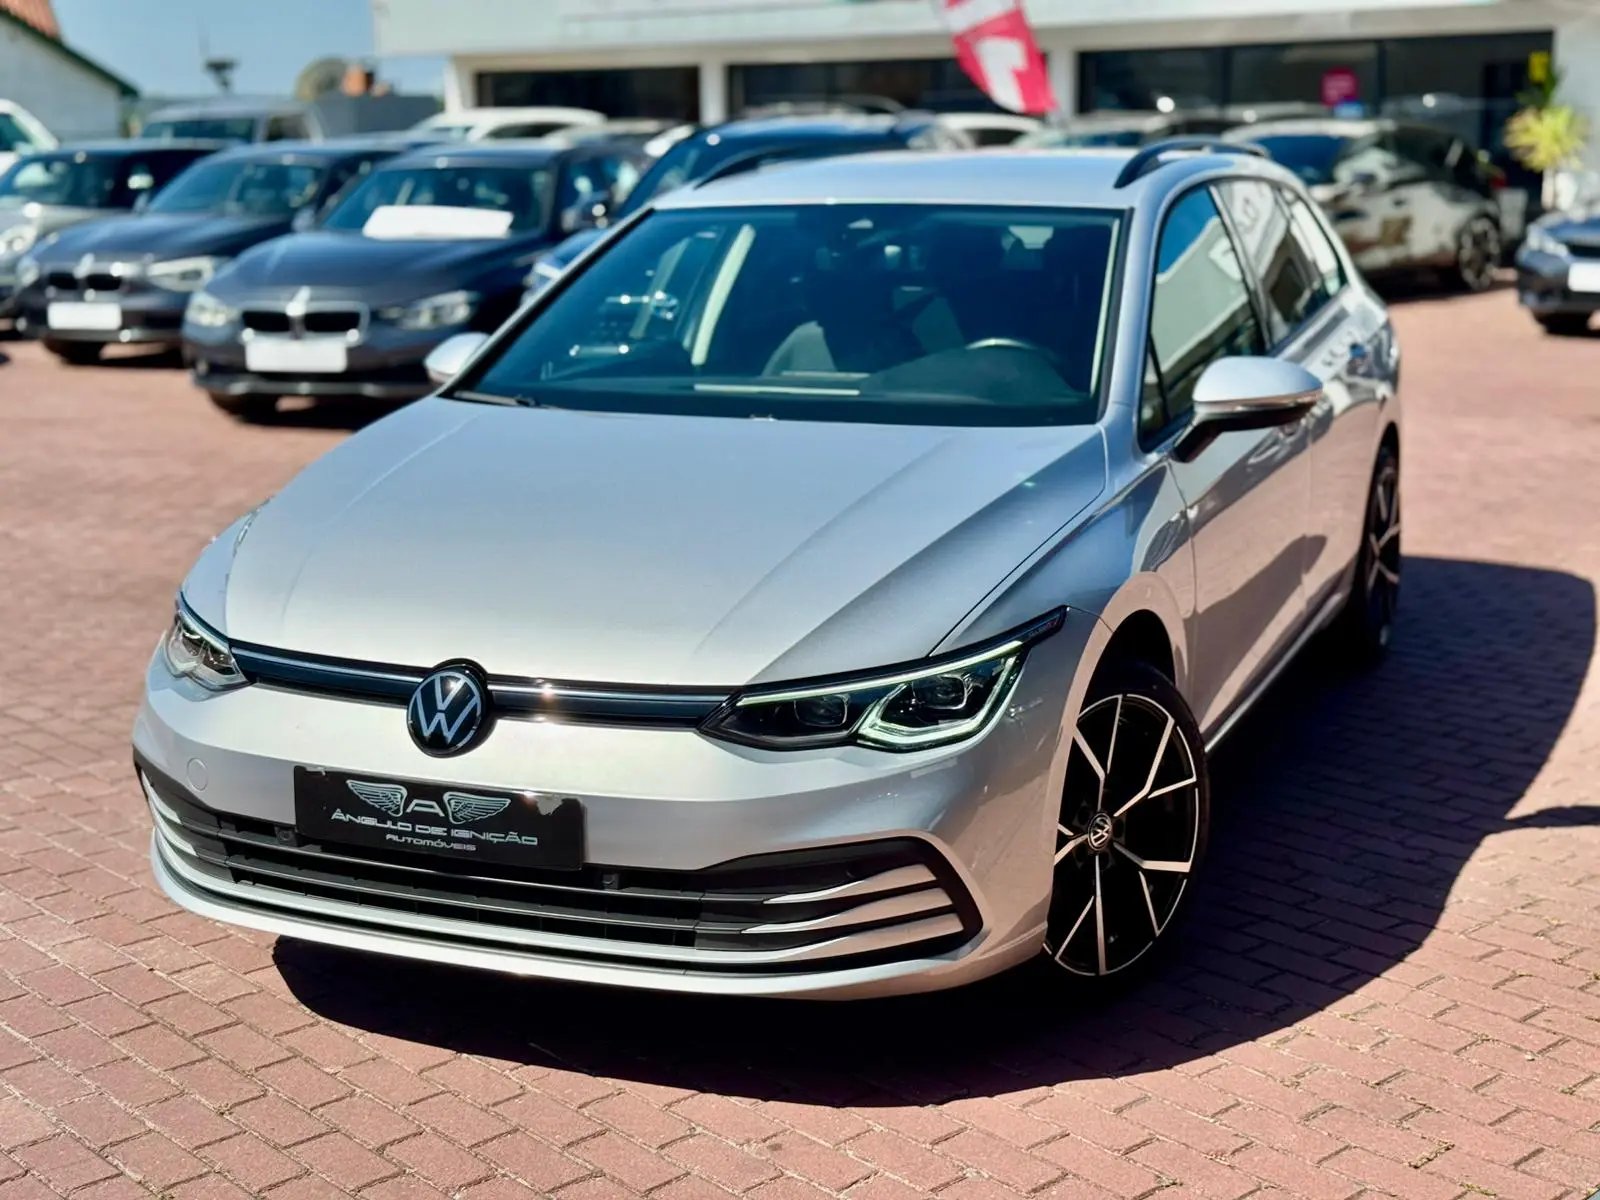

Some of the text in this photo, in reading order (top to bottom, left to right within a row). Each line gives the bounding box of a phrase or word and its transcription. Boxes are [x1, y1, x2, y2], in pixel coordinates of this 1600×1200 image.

[412, 671, 481, 745] VW
[406, 799, 445, 816] A
[331, 808, 538, 846] ÂNGULO DE IGNIÇÃO
